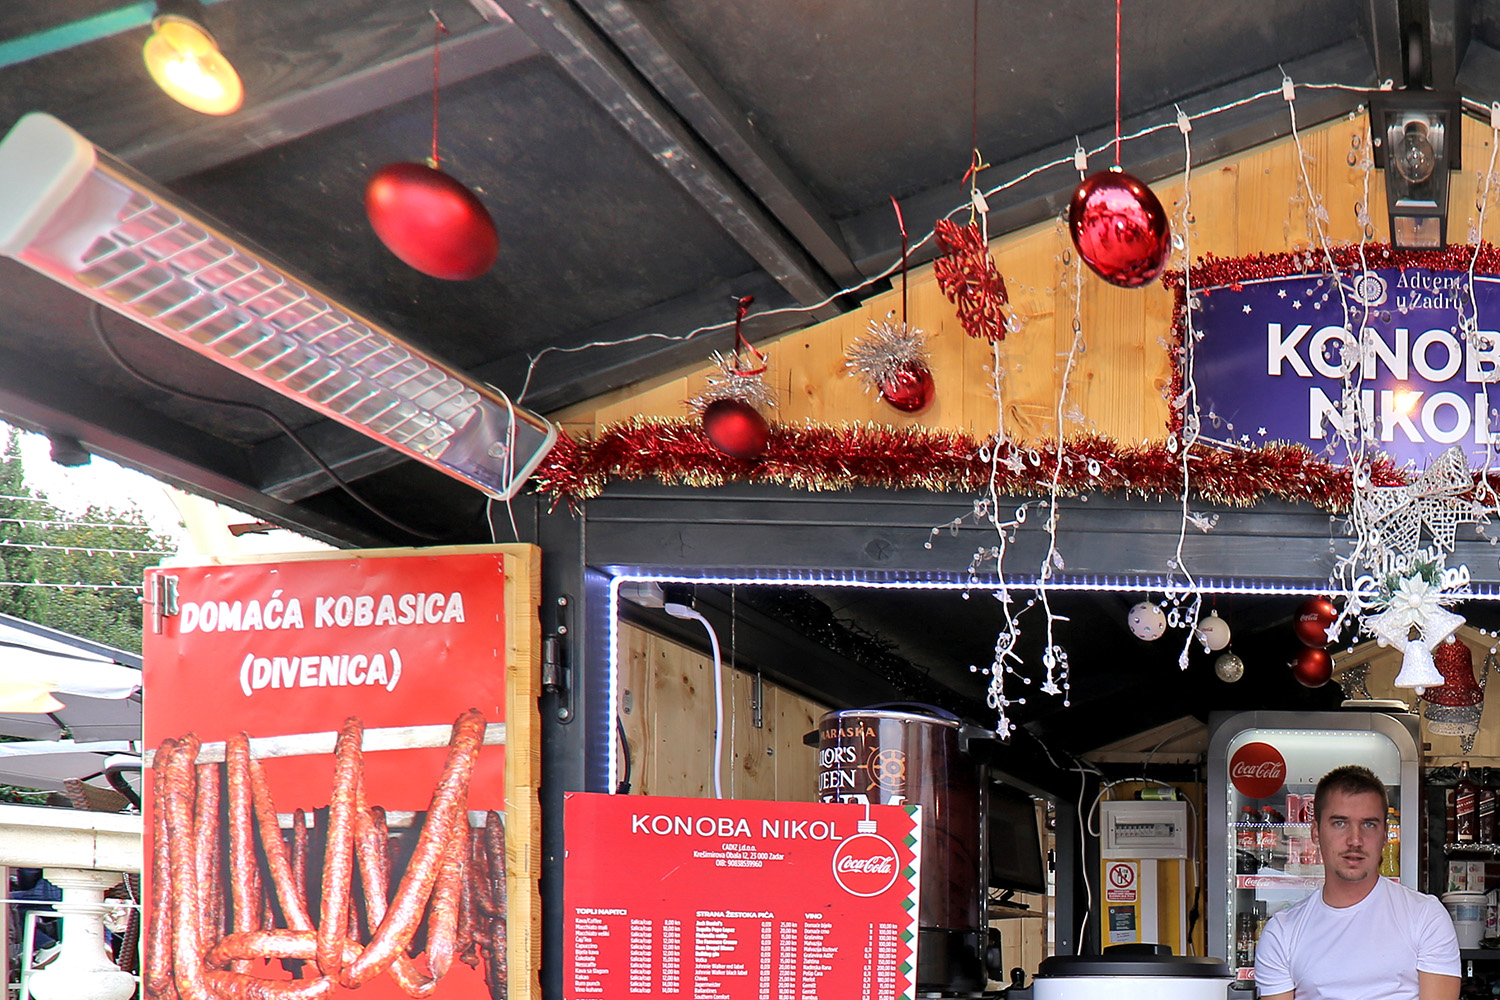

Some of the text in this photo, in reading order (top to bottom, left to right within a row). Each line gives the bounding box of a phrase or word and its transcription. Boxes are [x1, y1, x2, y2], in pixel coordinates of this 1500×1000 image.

[1396, 272, 1461, 290] Advent
[178, 589, 466, 634] DOMAĆA KOBASICA
[239, 648, 402, 696] (DIVENICA)
[1232, 761, 1284, 778] Coca-Cola
[631, 814, 844, 841] KONOBA NIKOL
[837, 854, 894, 874] Coca-Cola
